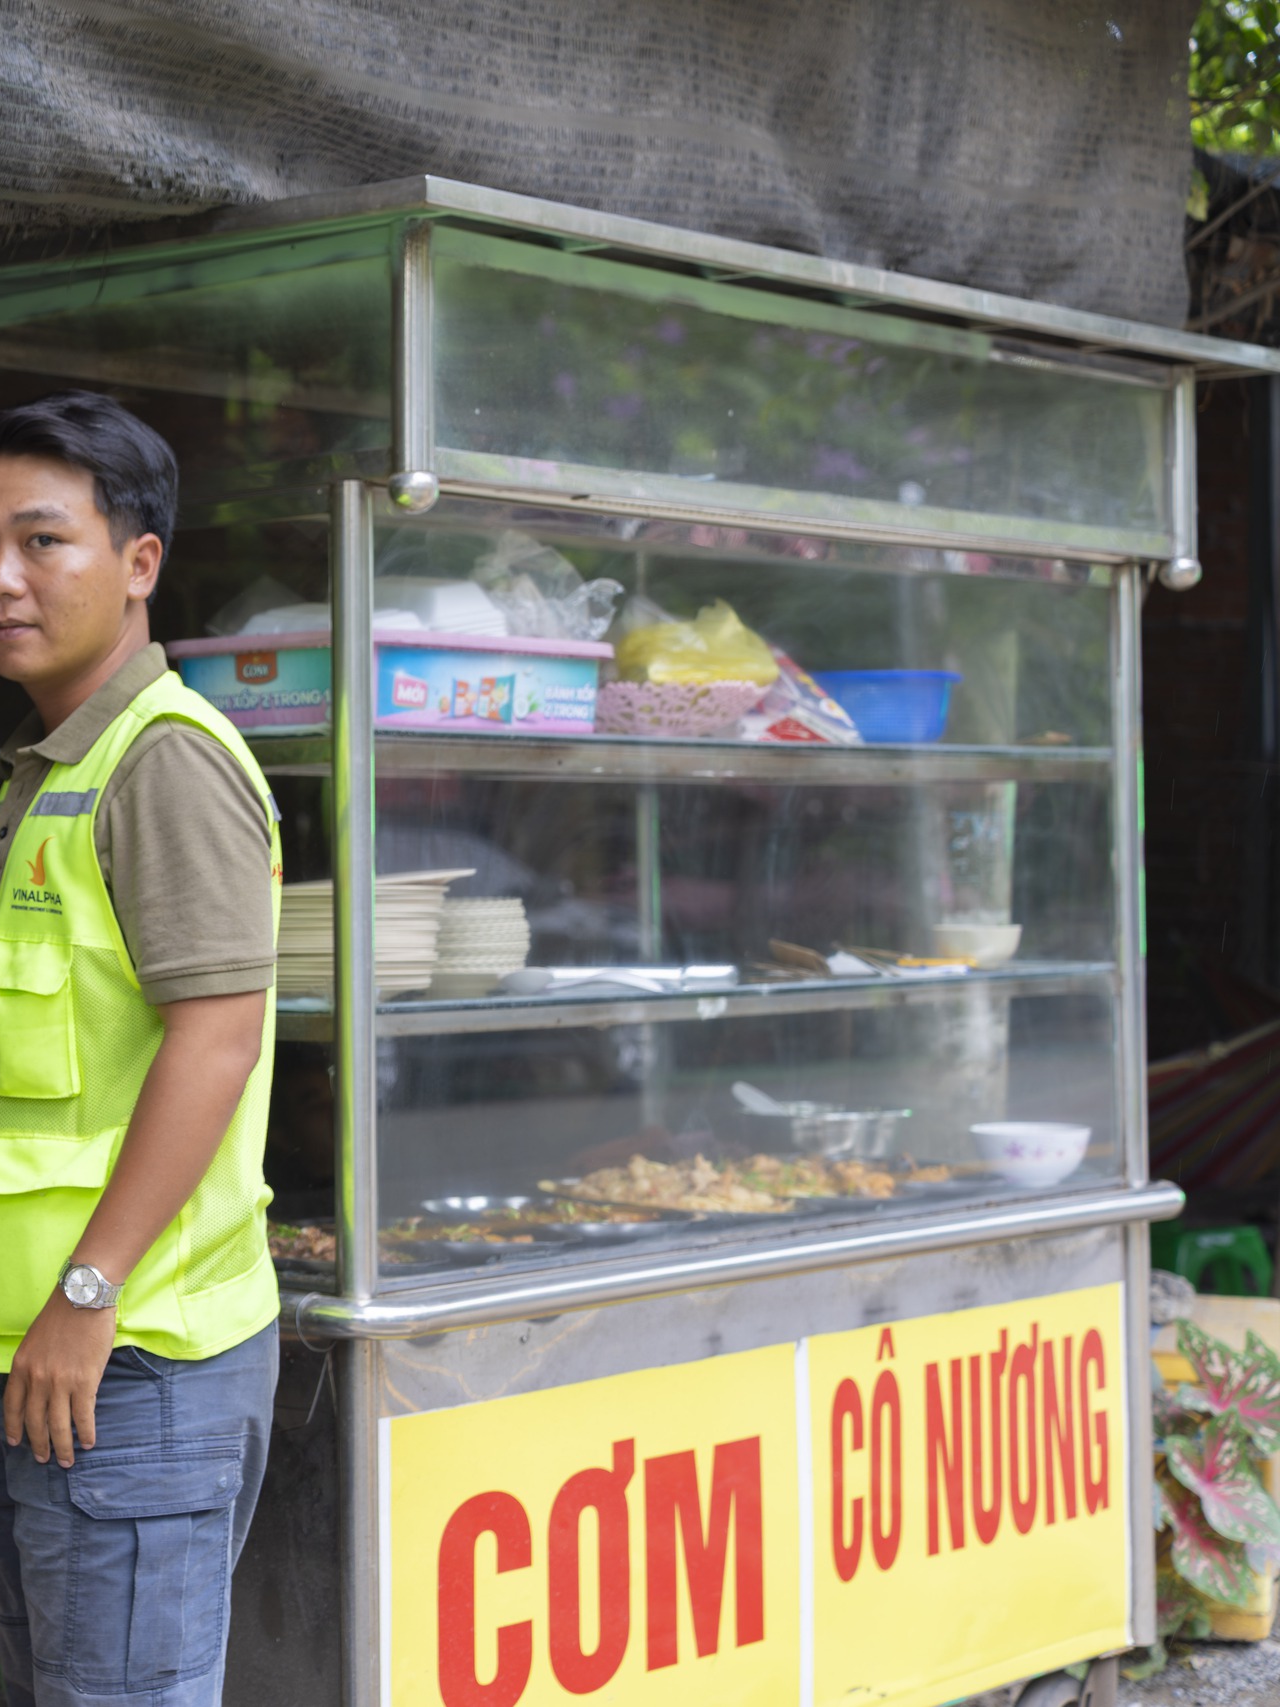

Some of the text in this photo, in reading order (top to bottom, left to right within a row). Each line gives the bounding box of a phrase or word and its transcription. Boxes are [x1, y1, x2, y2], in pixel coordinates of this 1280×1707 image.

[232, 688, 259, 710] XỐP
[261, 694, 271, 709] 2
[273, 690, 321, 708] TRONG
[12, 888, 62, 905] VINALPHA
[831, 1322, 1110, 1583] CÔ NƯƠNG
[437, 1436, 765, 1707] CƠM
